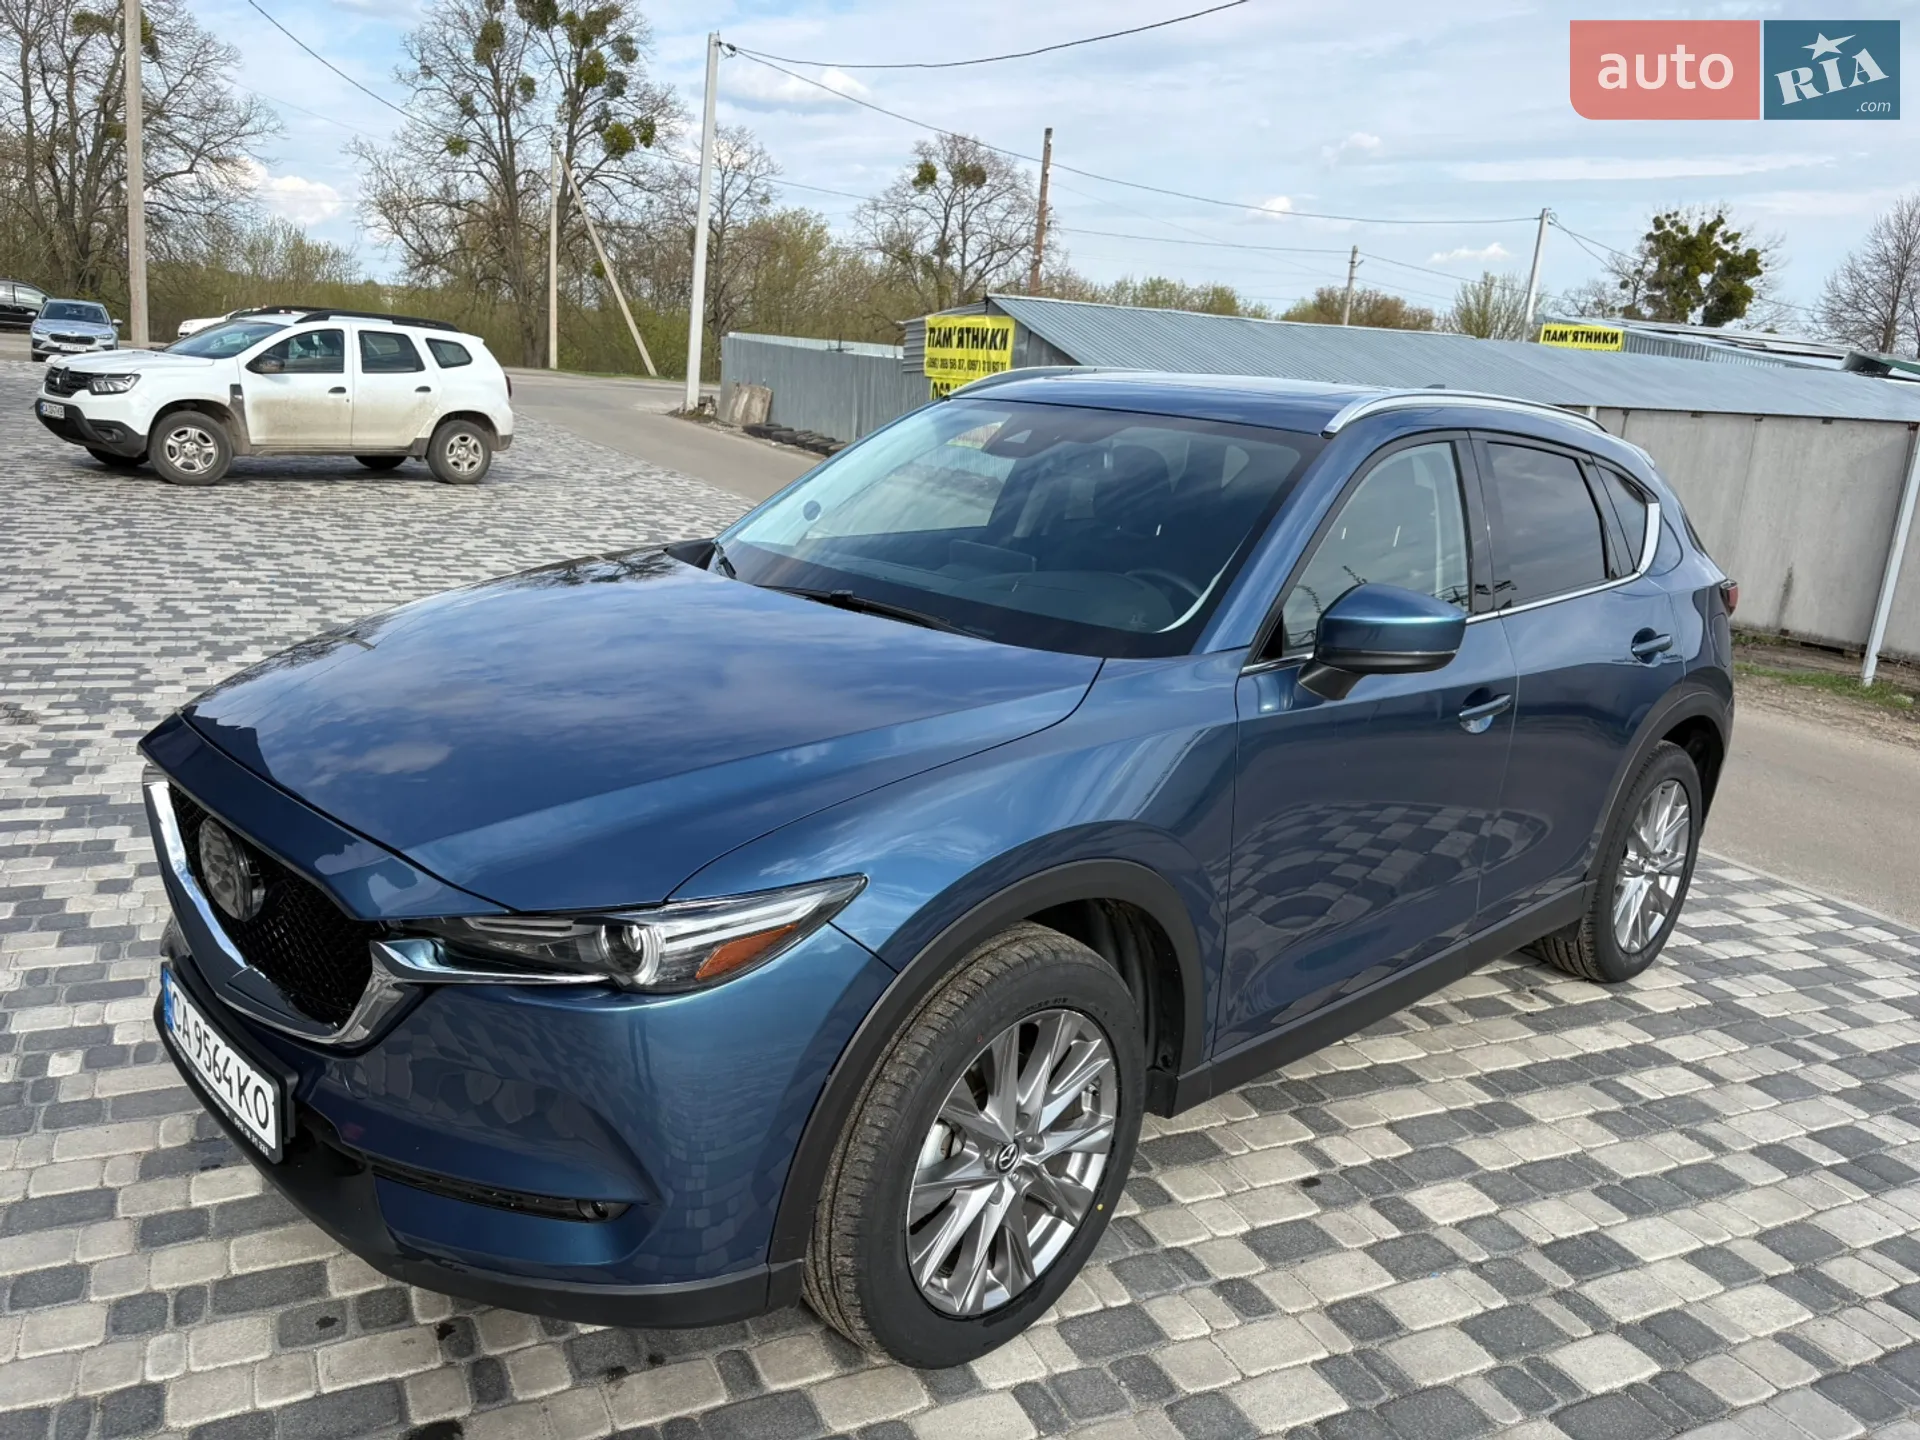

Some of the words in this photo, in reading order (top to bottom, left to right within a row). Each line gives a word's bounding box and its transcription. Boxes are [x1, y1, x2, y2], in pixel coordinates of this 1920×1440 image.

[928, 326, 1010, 351] ПАМ'ЯТНИКИ
[1543, 329, 1619, 344] ПАМ'ЯТНИКИ
[172, 990, 192, 1049] CA
[194, 1020, 233, 1099] 9564
[237, 1064, 270, 1130] KO
